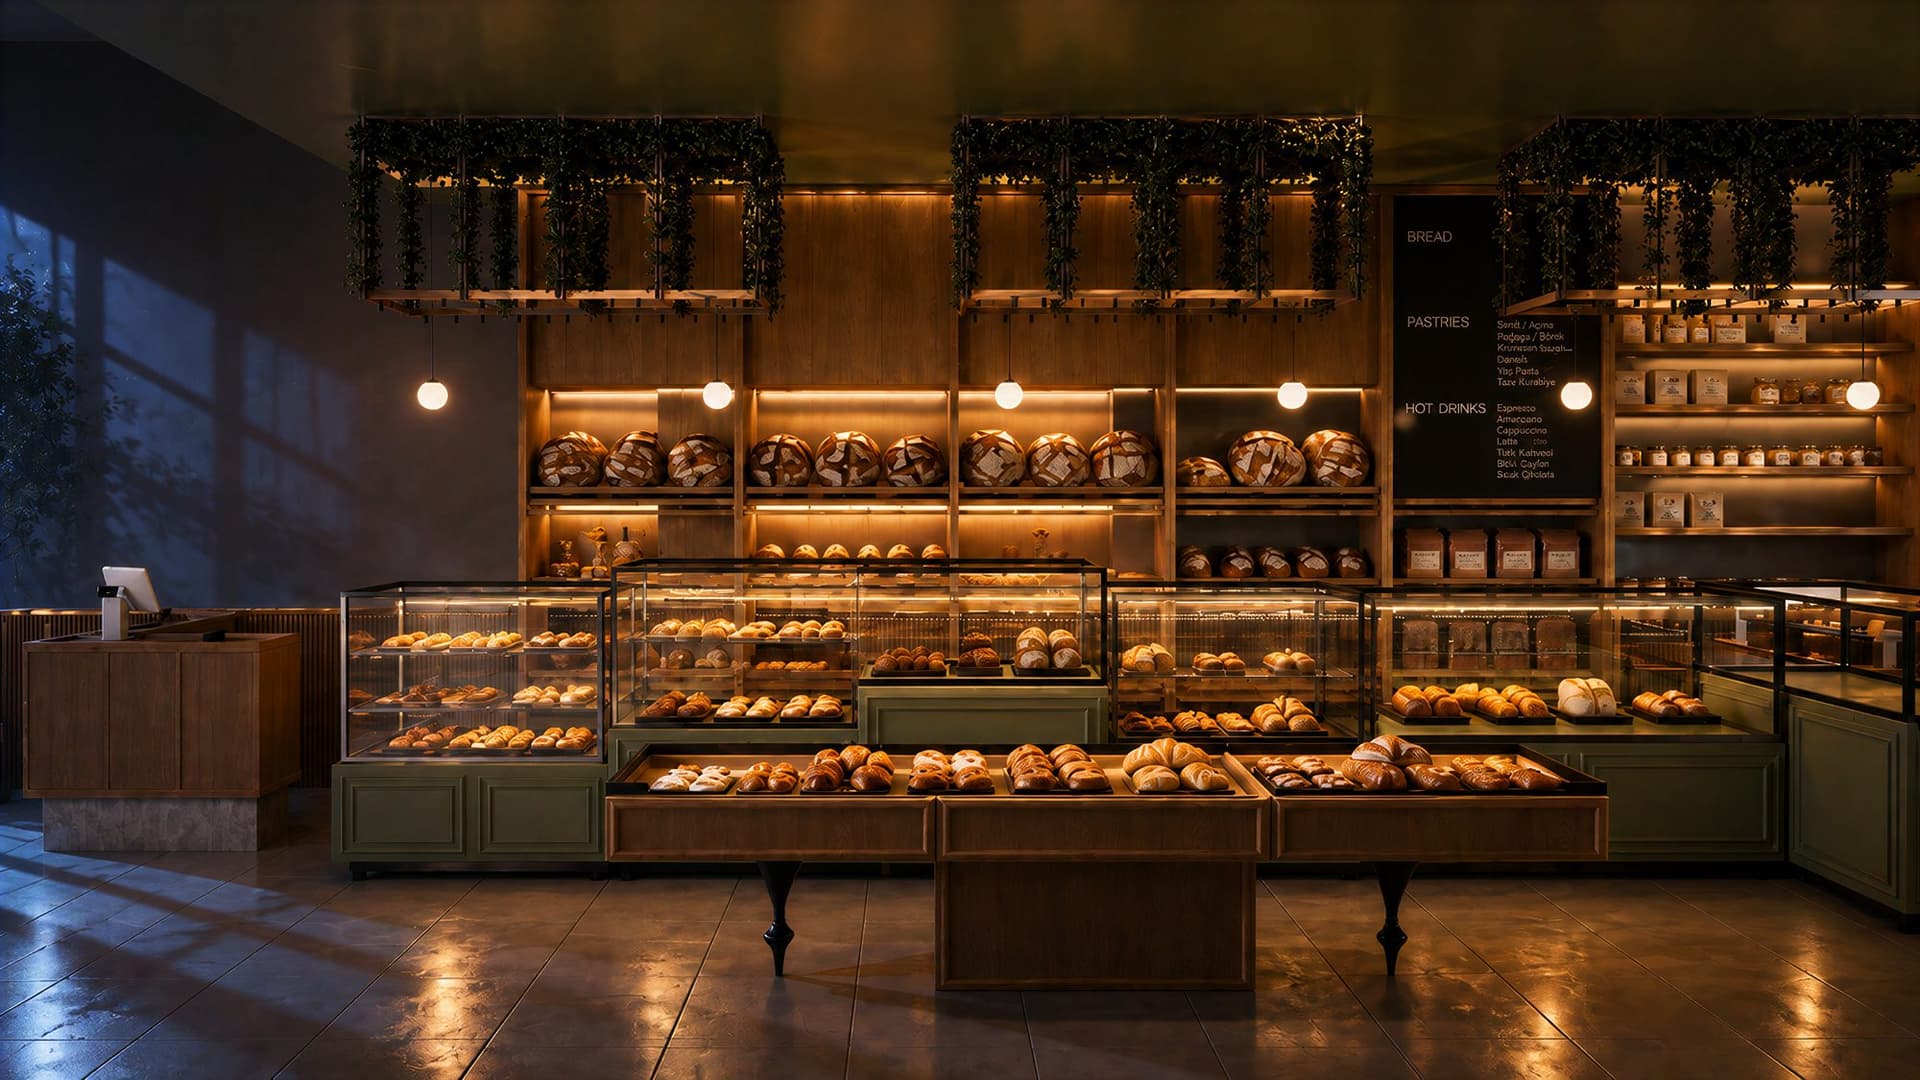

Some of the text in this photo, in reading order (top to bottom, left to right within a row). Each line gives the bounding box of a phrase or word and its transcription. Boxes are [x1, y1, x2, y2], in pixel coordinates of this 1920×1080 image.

[1407, 231, 1453, 243] BREAD
[1407, 316, 1470, 328] PASTRIES
[1405, 403, 1487, 414] HOT DRINKS
